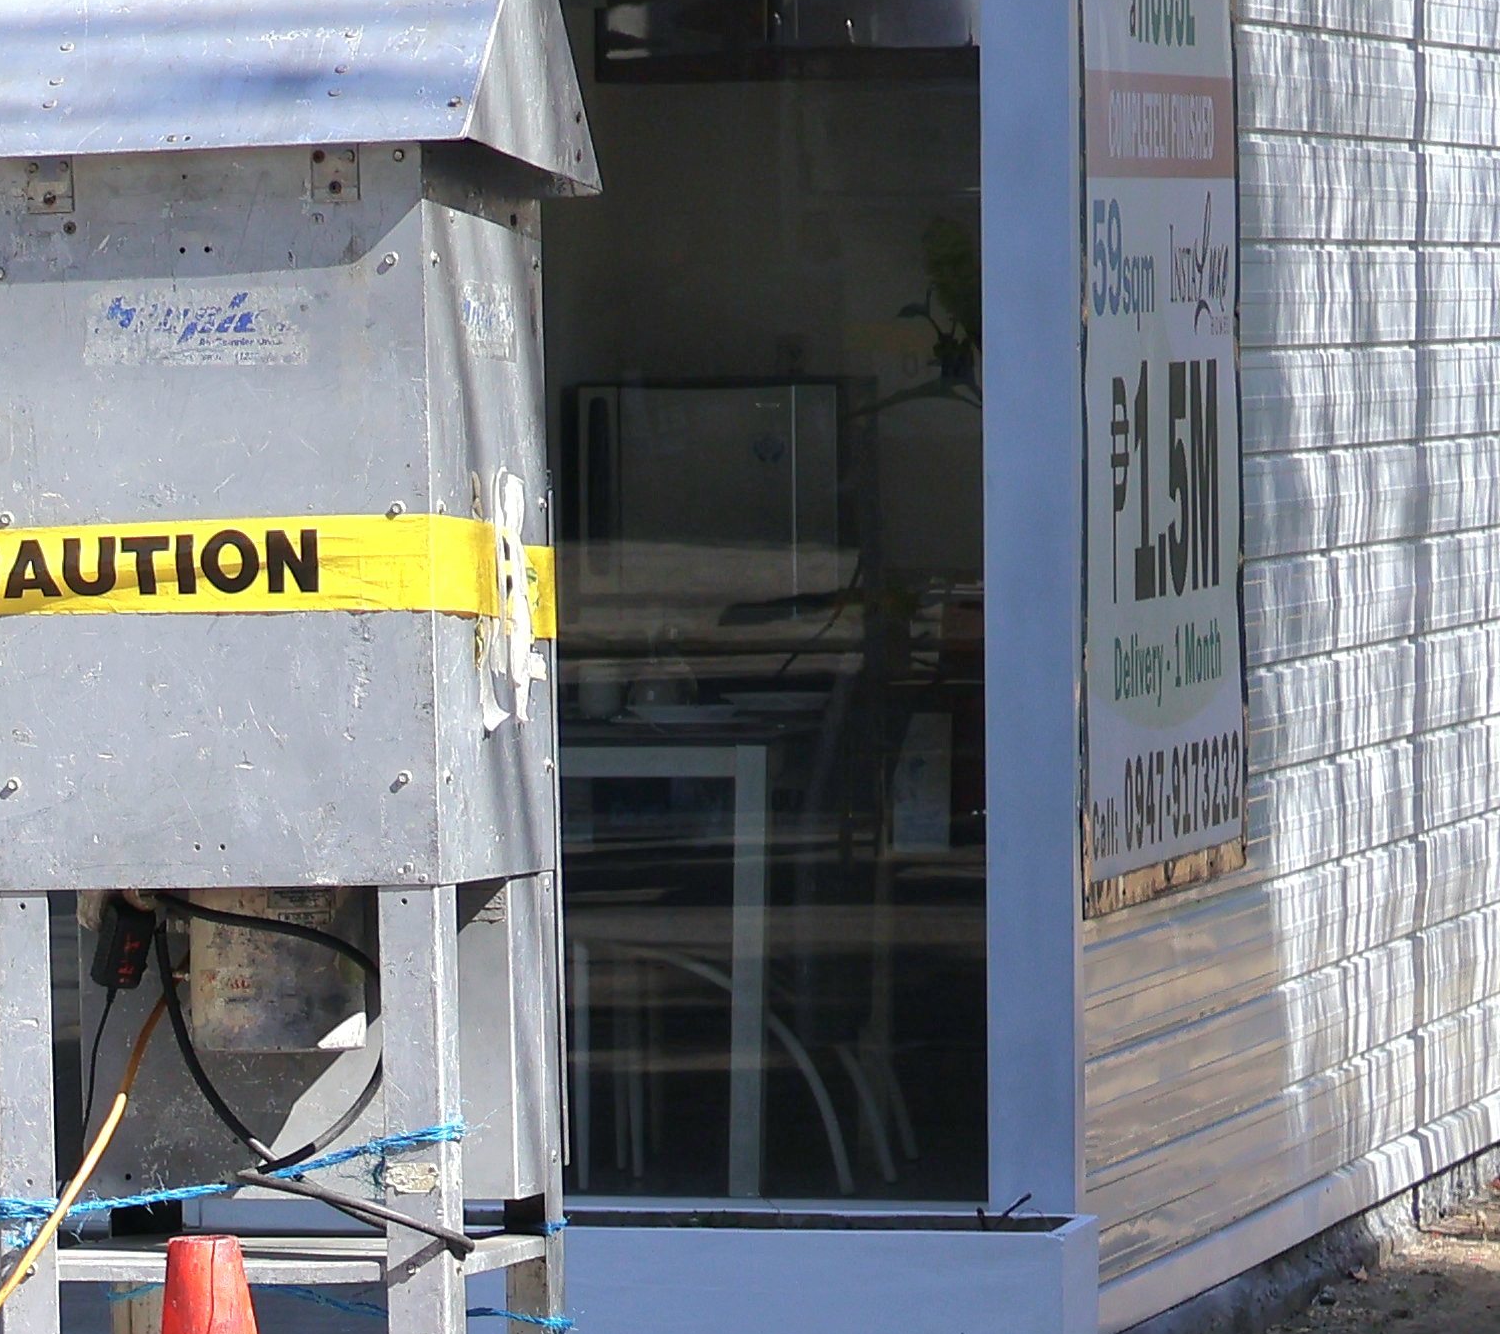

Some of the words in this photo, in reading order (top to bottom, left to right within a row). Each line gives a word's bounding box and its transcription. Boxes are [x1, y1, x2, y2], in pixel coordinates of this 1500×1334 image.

[1108, 89, 1170, 160] COMPLETELY
[1171, 93, 1215, 161] FINISHED
[1115, 633, 1164, 707] Delivery
[1175, 625, 1181, 687] 1
[1185, 618, 1222, 686] Month
[1093, 798, 1118, 861] Call:
[1124, 730, 1240, 851] 0947-9173232
